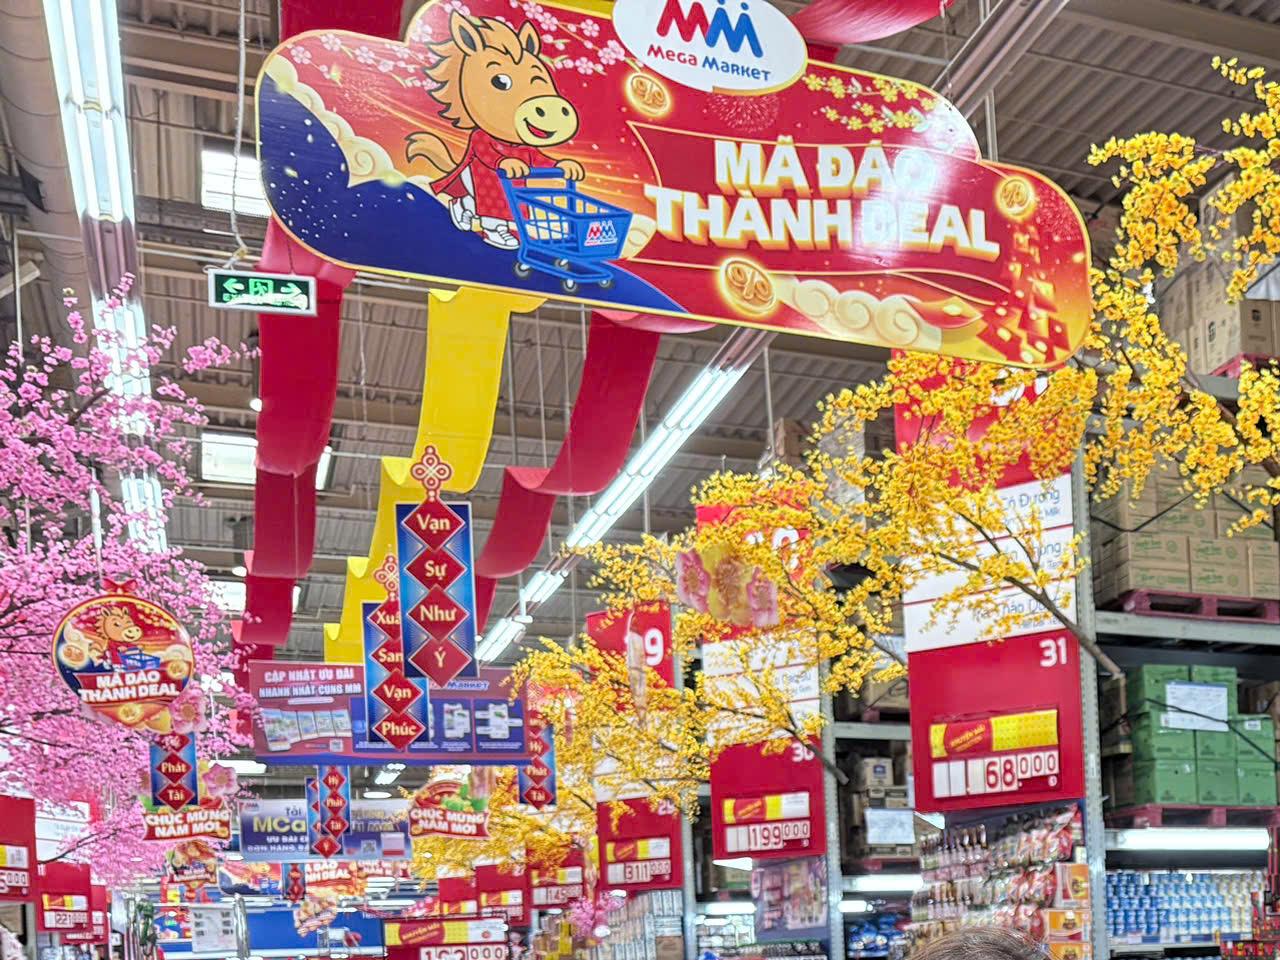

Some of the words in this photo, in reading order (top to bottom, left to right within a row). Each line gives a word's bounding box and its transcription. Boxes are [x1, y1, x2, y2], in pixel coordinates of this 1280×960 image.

[416, 513, 451, 535] Vạn
[424, 559, 447, 582] Sự
[376, 610, 400, 626] Xuâ
[419, 605, 458, 622] Như
[377, 648, 404, 664] San
[433, 646, 447, 669] Ý
[1038, 637, 1068, 668] 31
[138, 682, 180, 699] DEAL
[382, 684, 412, 702] Vạn
[381, 720, 418, 737] Phúc
[161, 760, 187, 773] Phát
[166, 788, 184, 800] Tài
